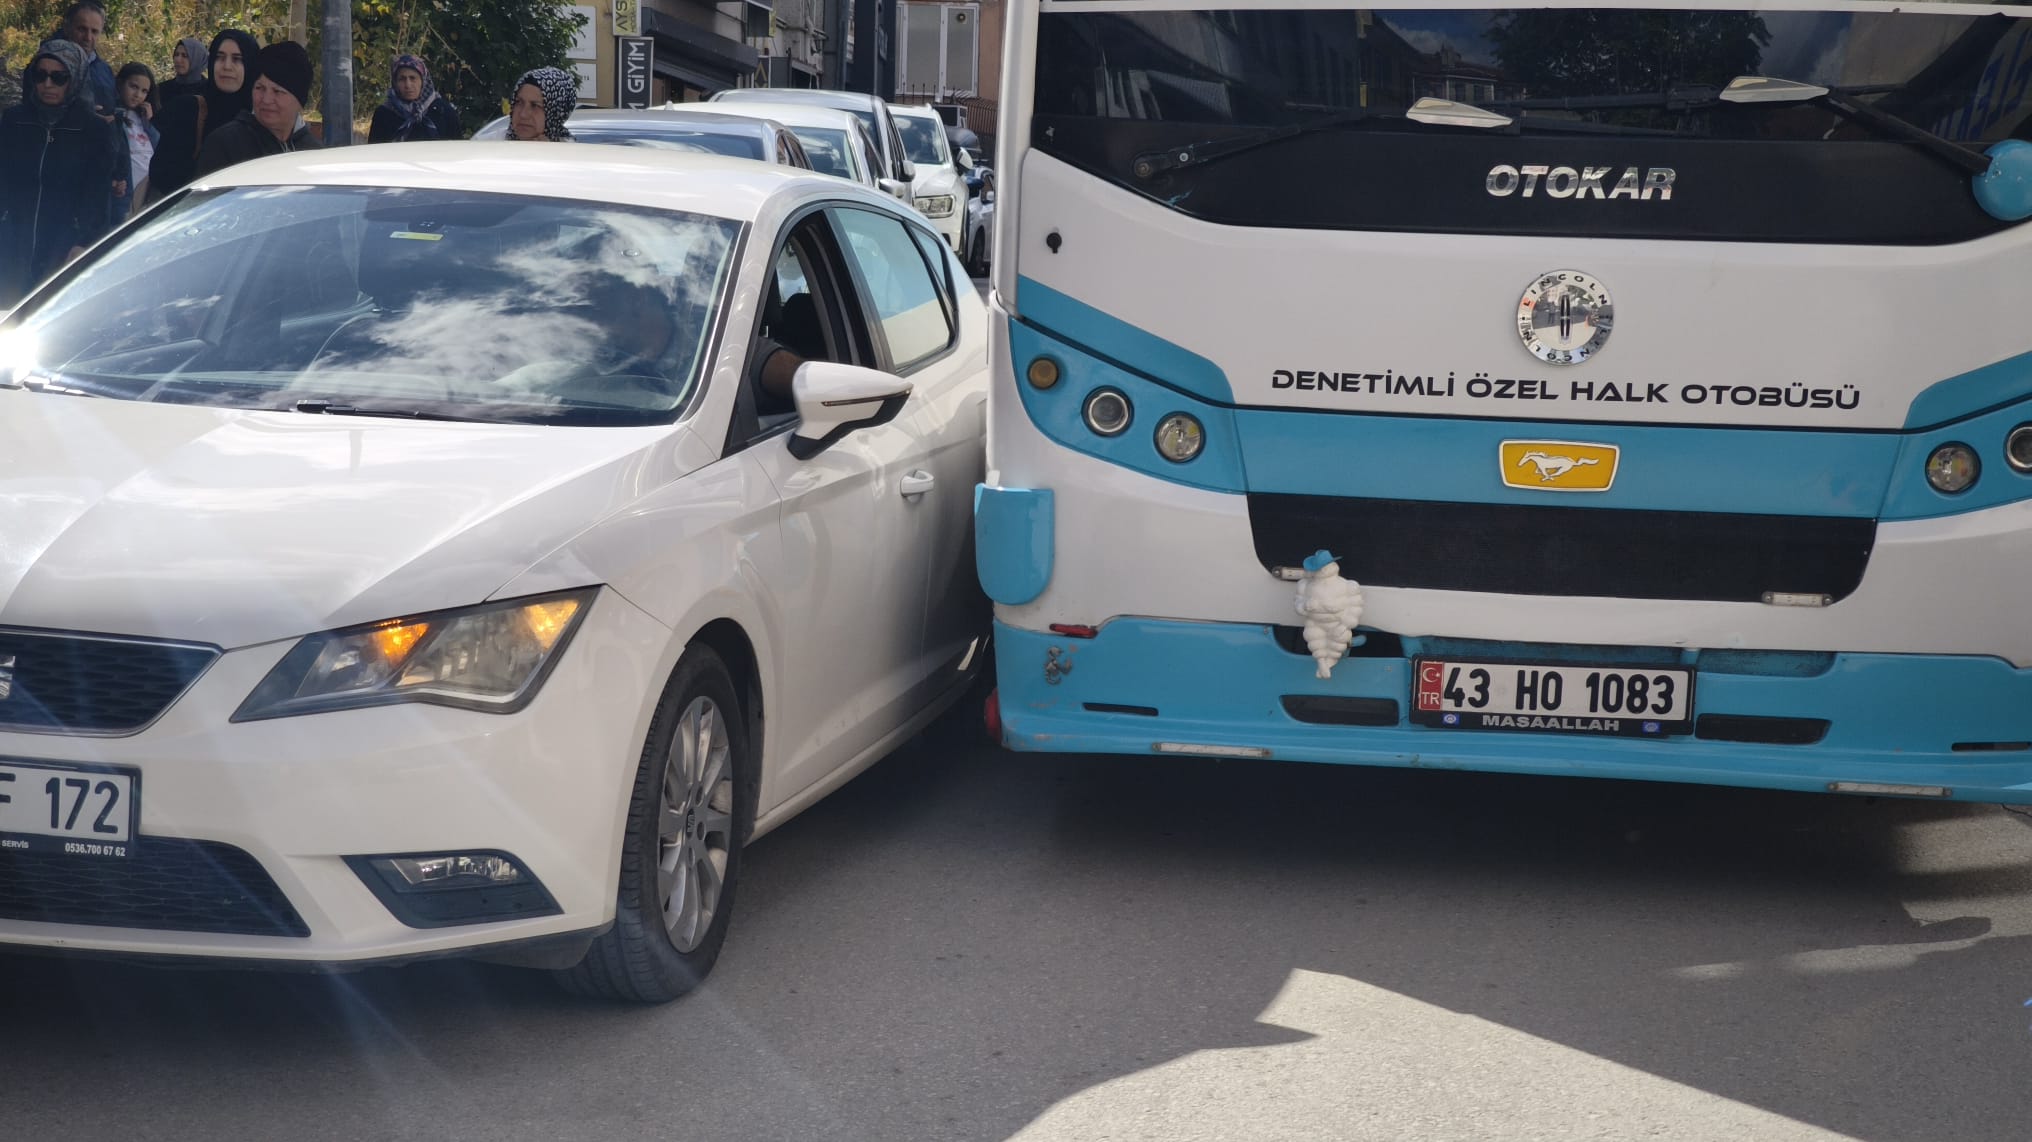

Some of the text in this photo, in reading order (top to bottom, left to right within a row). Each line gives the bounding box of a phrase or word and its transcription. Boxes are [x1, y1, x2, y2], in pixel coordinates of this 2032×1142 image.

[627, 41, 646, 93] GİYİM
[1486, 164, 1677, 200] OTOKAR
[1523, 273, 1608, 307] LINCOLN
[1272, 368, 1861, 411] DENETİMLİ ÖZEL HALK OTOBÜSÜ
[1421, 691, 1440, 705] TR
[1443, 666, 1491, 709] 43
[1586, 671, 1675, 715] 1083
[1483, 714, 1620, 732] MASAALLAH
[45, 776, 120, 835] 172
